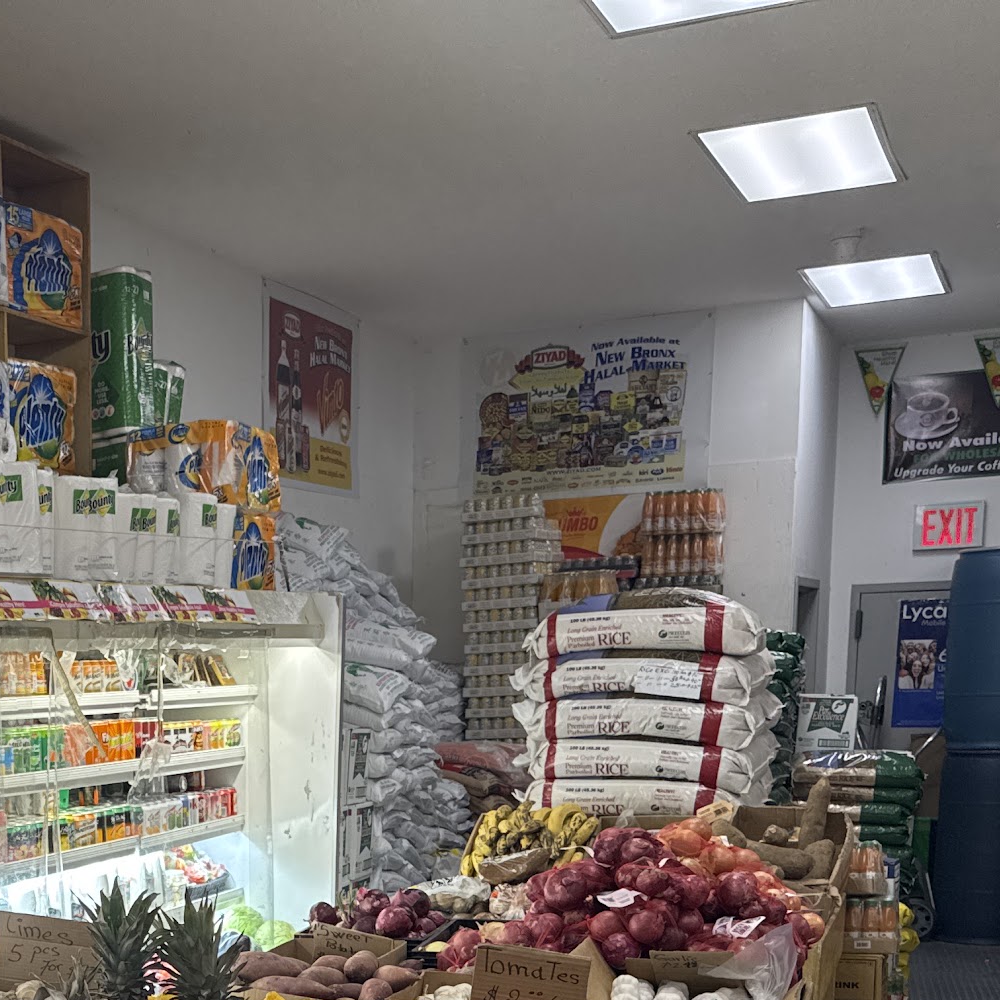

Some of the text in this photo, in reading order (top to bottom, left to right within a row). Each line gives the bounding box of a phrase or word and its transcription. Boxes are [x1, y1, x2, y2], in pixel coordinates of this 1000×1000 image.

[591, 336, 681, 352] Now Available at
[534, 350, 567, 365] ZIYAD
[595, 346, 677, 367] NEW BRONX
[584, 365, 628, 385] HALAL
[630, 359, 688, 373] MARKET
[903, 432, 1000, 452] Now Avail
[947, 447, 1000, 462] WHOLES
[894, 458, 1000, 479] Upgrade Your Coff
[556, 516, 599, 534] UMBO
[921, 508, 978, 547] EXIT
[902, 604, 948, 623] Lyca
[567, 623, 622, 634] Long Grain Enriched
[567, 634, 596, 643] Premium
[598, 631, 632, 647] RICE
[592, 681, 626, 692] RICE
[812, 711, 845, 722] Excellence
[567, 722, 595, 730] Premium
[598, 720, 631, 735] RICE
[595, 762, 629, 776] RICE
[591, 804, 626, 816] RICE
[7, 915, 74, 946] Limes
[8, 943, 60, 964] 5 pcs
